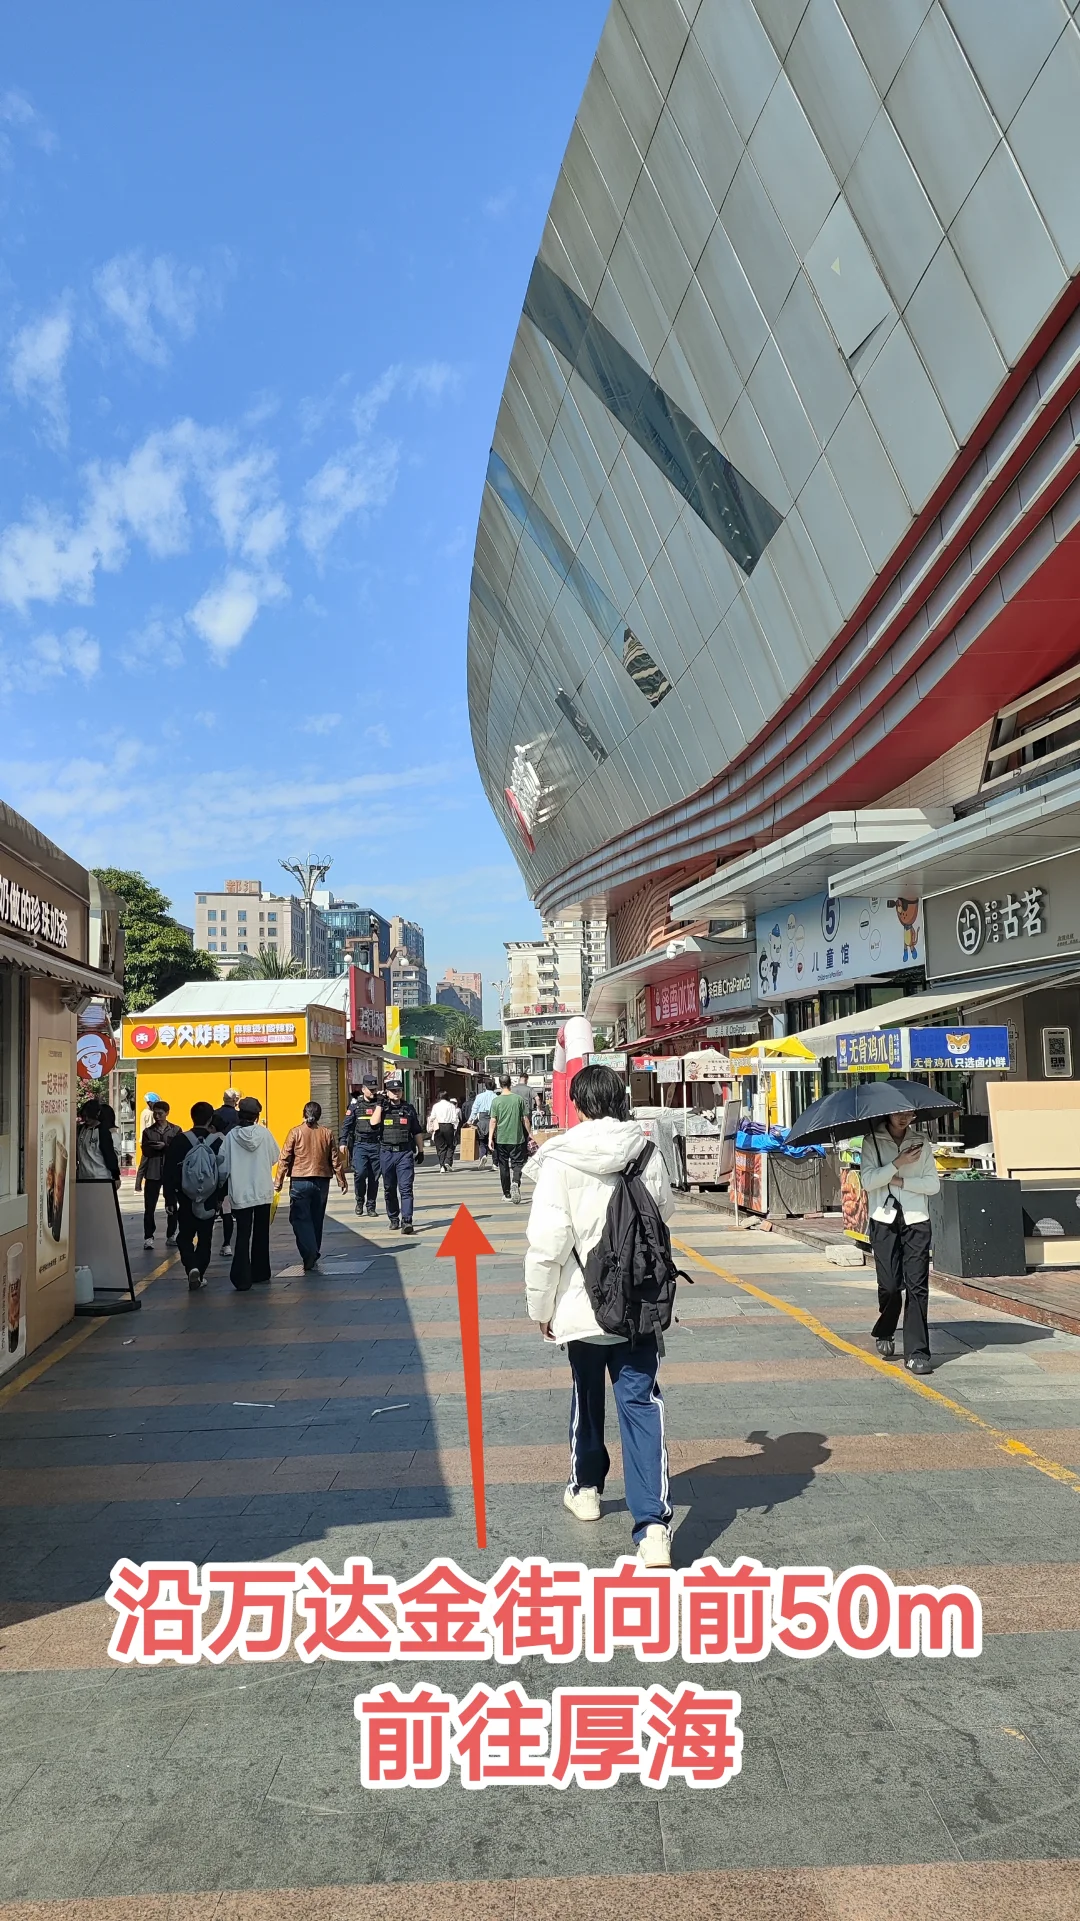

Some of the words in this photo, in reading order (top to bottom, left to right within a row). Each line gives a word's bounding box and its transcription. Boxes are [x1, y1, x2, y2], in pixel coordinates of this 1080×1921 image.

[825, 898, 836, 935] 5
[991, 900, 999, 943] GOOD
[999, 887, 1043, 940] 古茗
[811, 943, 850, 973] 儿童馆
[661, 977, 697, 1019] 蜜雪冰城
[849, 1034, 888, 1063] 无骨鸡爪
[914, 1057, 1007, 1068] 无骨鸡爪只选卤小鲜
